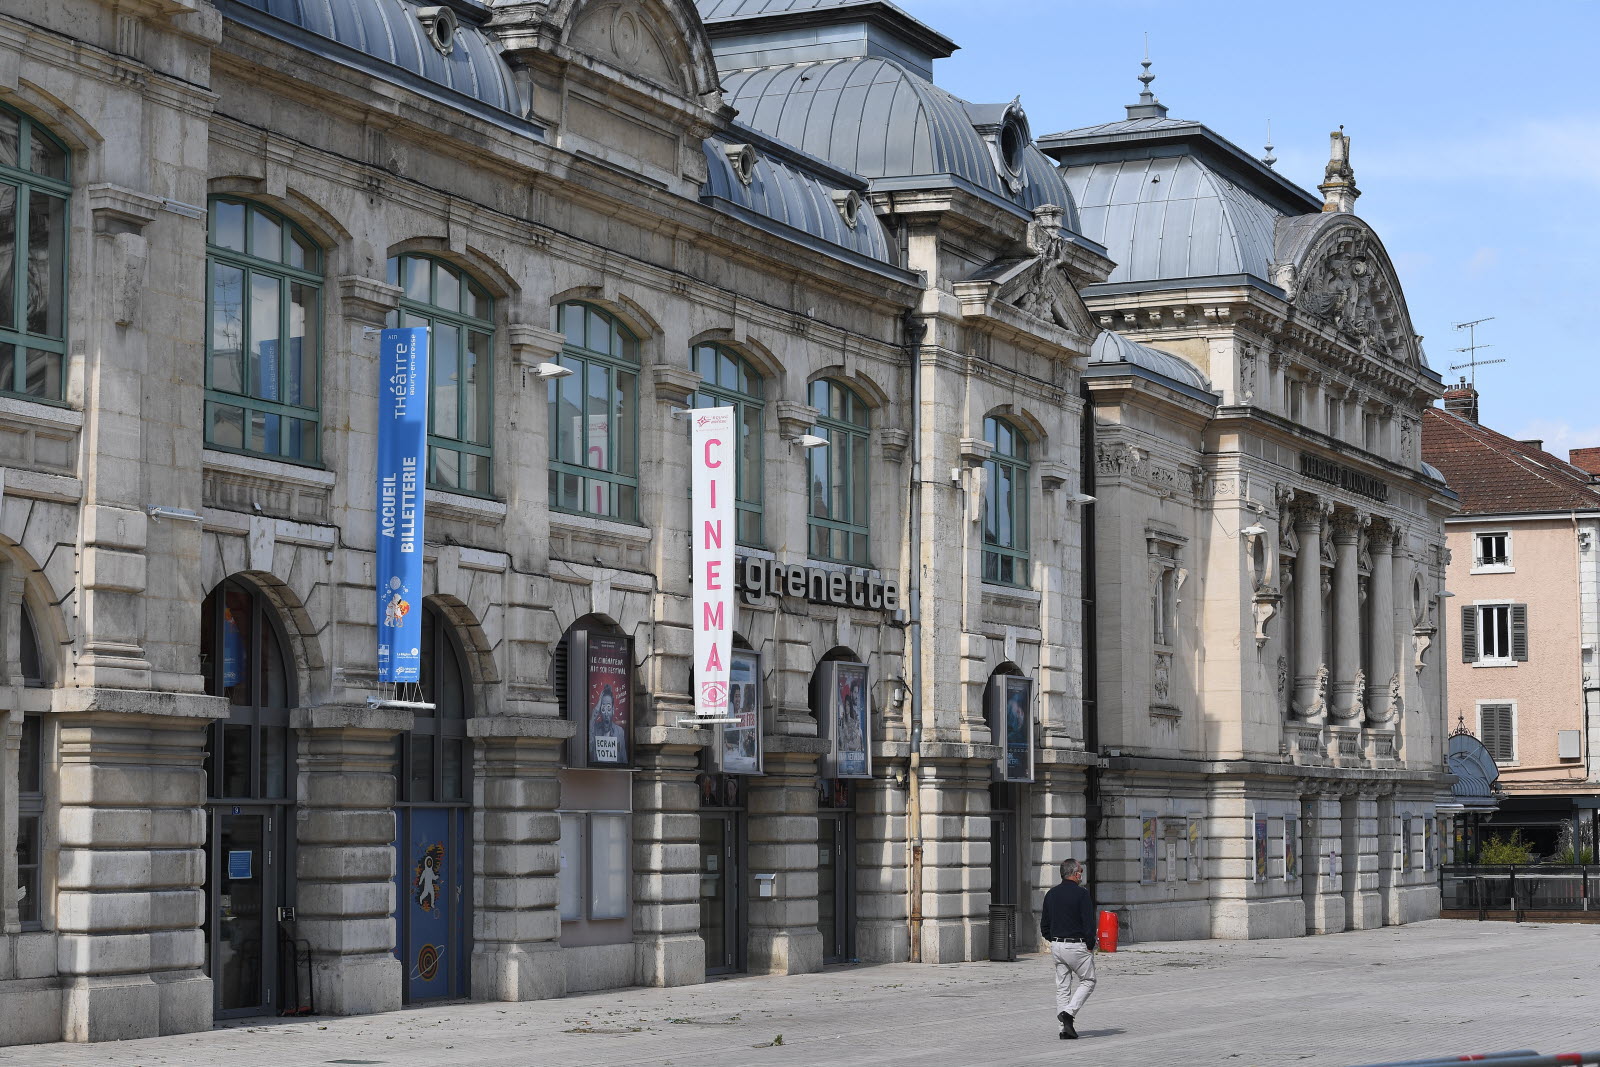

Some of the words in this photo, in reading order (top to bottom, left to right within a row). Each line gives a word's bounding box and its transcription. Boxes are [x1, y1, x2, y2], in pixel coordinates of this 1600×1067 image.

[382, 472, 396, 538] ACCUEIL
[400, 456, 416, 553] BILLETTERIE
[703, 438, 724, 672] CINEMA
[745, 556, 900, 611] grenette
[597, 740, 616, 748] ECRAN
[597, 750, 617, 758] TOTAL
